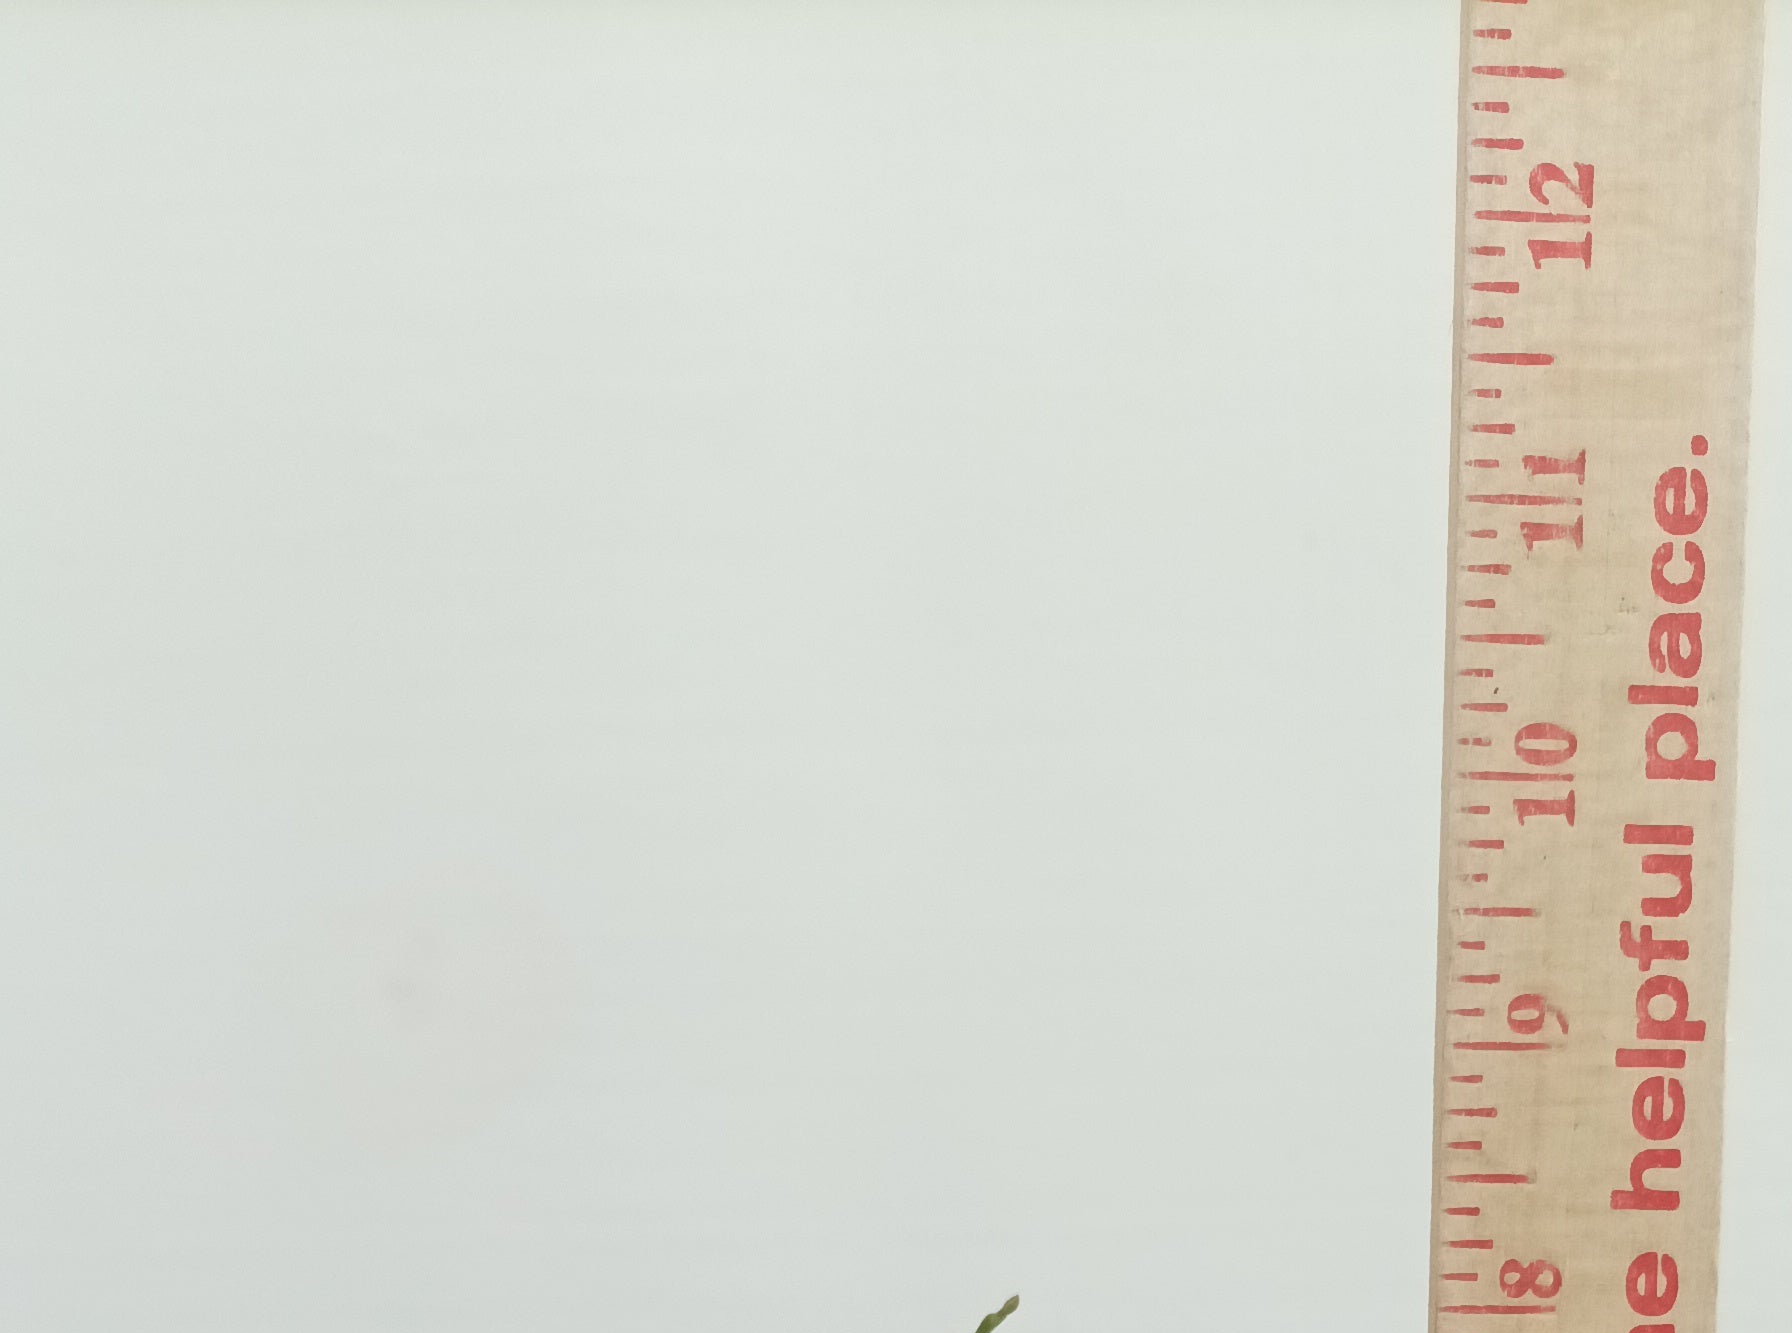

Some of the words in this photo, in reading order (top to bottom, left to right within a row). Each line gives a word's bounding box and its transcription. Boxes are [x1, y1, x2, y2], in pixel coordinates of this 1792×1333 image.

[1527, 161, 1595, 271] 12
[1519, 448, 1587, 557] 11
[1626, 433, 1716, 783] place.
[1512, 721, 1578, 828] 10
[1506, 992, 1569, 1036] 9
[1610, 822, 1707, 1213] helpful
[1498, 1258, 1563, 1300] 8
